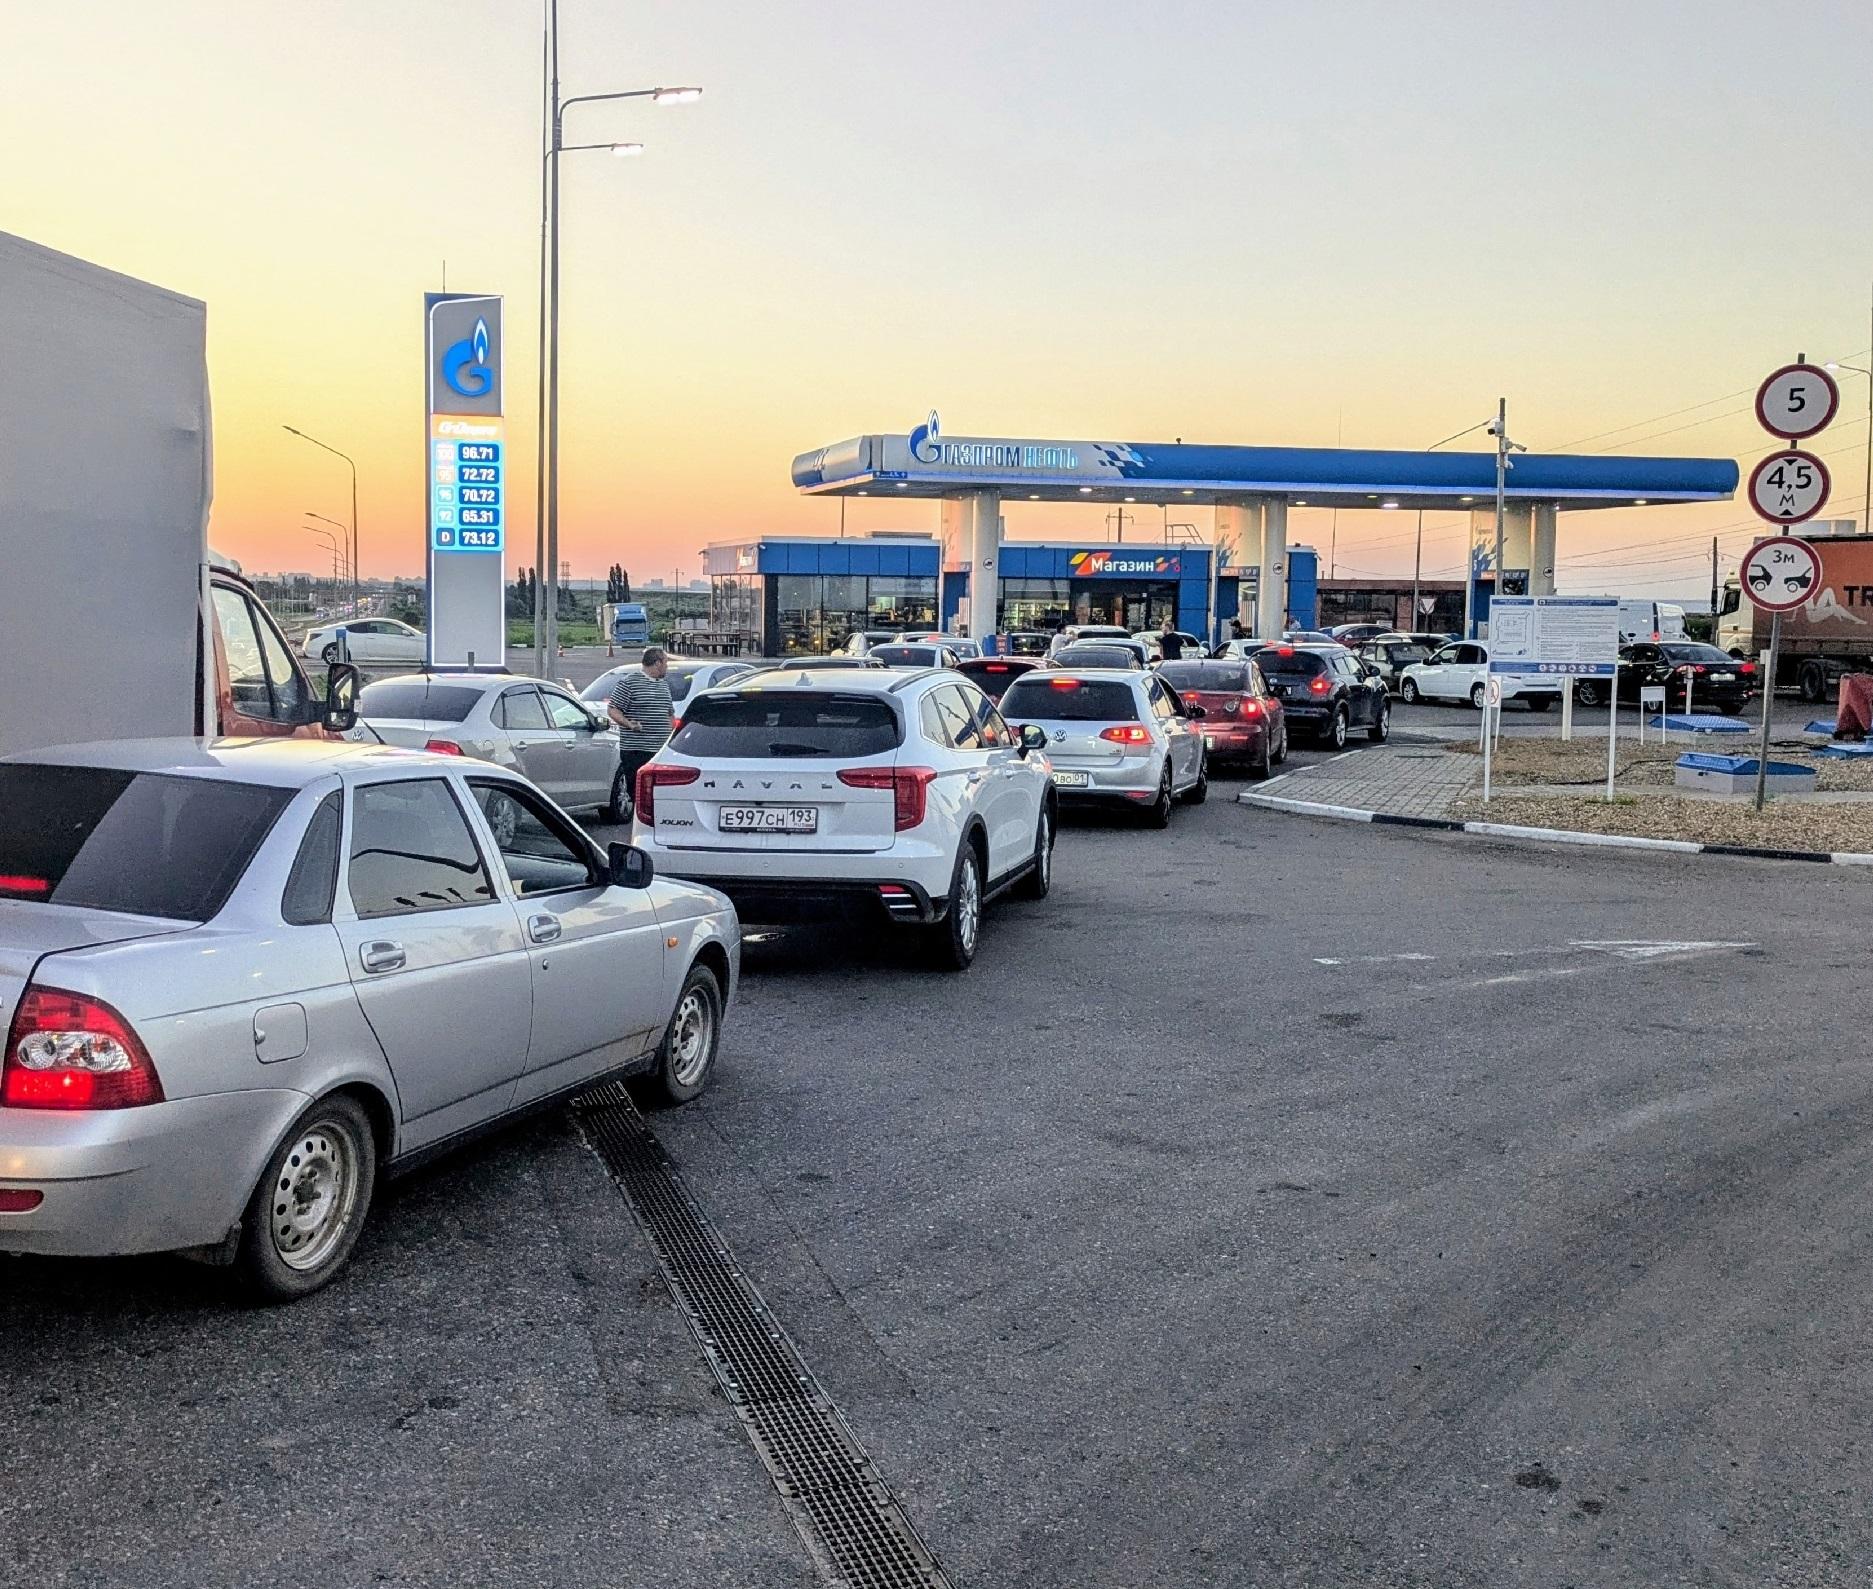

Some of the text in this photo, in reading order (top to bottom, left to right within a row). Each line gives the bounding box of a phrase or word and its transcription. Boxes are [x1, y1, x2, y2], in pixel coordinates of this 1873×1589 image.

[1787, 387, 1806, 413] 5
[462, 446, 494, 460] 96.71
[942, 443, 1079, 470] ГАЗПРОМ НЕФТЬ
[462, 467, 496, 481] 72.72
[1766, 465, 1813, 493] 4,5
[462, 488, 496, 502] 70.72
[462, 509, 494, 523] 65.31
[441, 531, 496, 545] D 73.12
[1091, 557, 1154, 572] Магазин
[789, 809, 812, 823] 193
